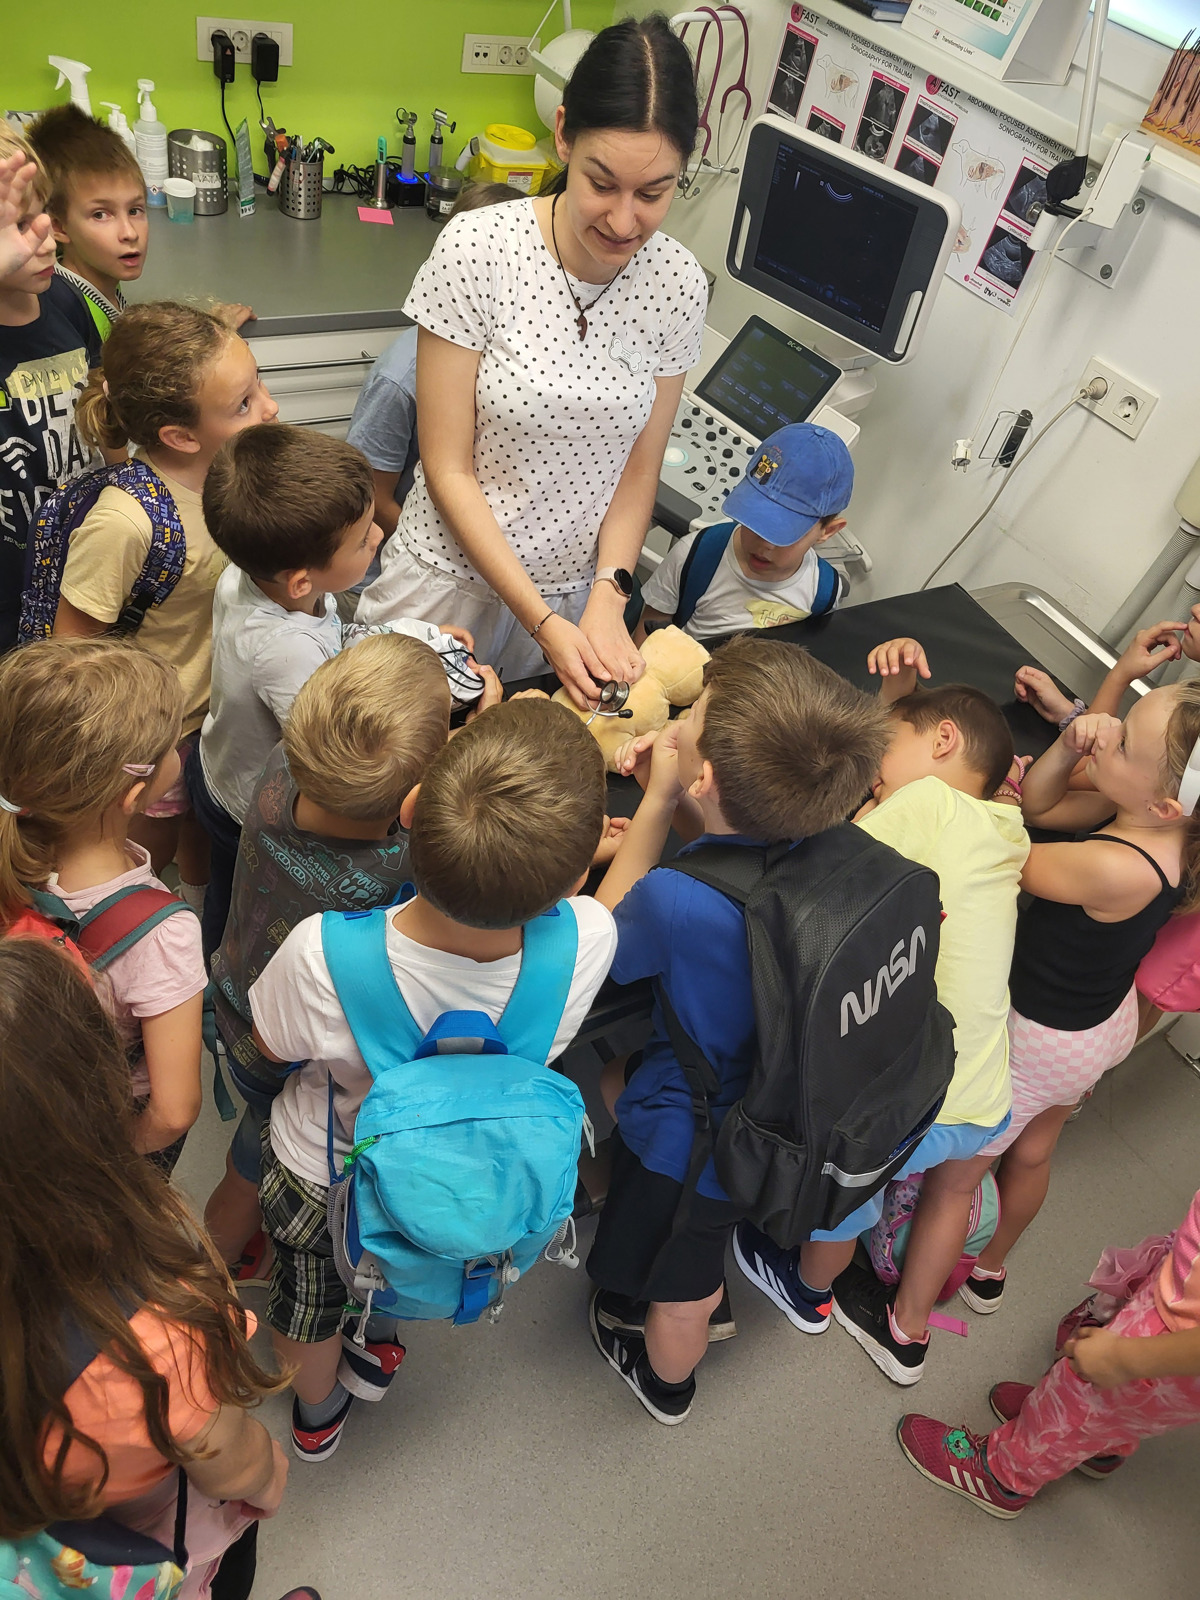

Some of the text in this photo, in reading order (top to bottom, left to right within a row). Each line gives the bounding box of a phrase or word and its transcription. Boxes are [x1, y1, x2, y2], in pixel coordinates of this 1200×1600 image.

[826, 20, 851, 38] ABDOMINAL
[850, 32, 870, 48] FOCUSED
[870, 40, 900, 62] ASSESSMENT
[902, 58, 916, 70] WITH
[850, 43, 881, 64] SONOGRAPHY
[881, 60, 892, 70] FOR
[893, 64, 912, 80] TRAUMA
[942, 36, 964, 52] Transforming
[938, 83, 960, 100] FAST
[968, 95, 1000, 117] ABDOMINAL
[1000, 111, 1026, 131] FOCUSED
[1025, 126, 1062, 151] ASSESSMENT
[998, 123, 1036, 150] SONOGRAPHY
[1036, 144, 1049, 157] FOR
[290, 848, 327, 886] PROGRAM
[307, 855, 330, 880] 64MB
[338, 878, 378, 906] UP!
[840, 925, 926, 1038] NASA
